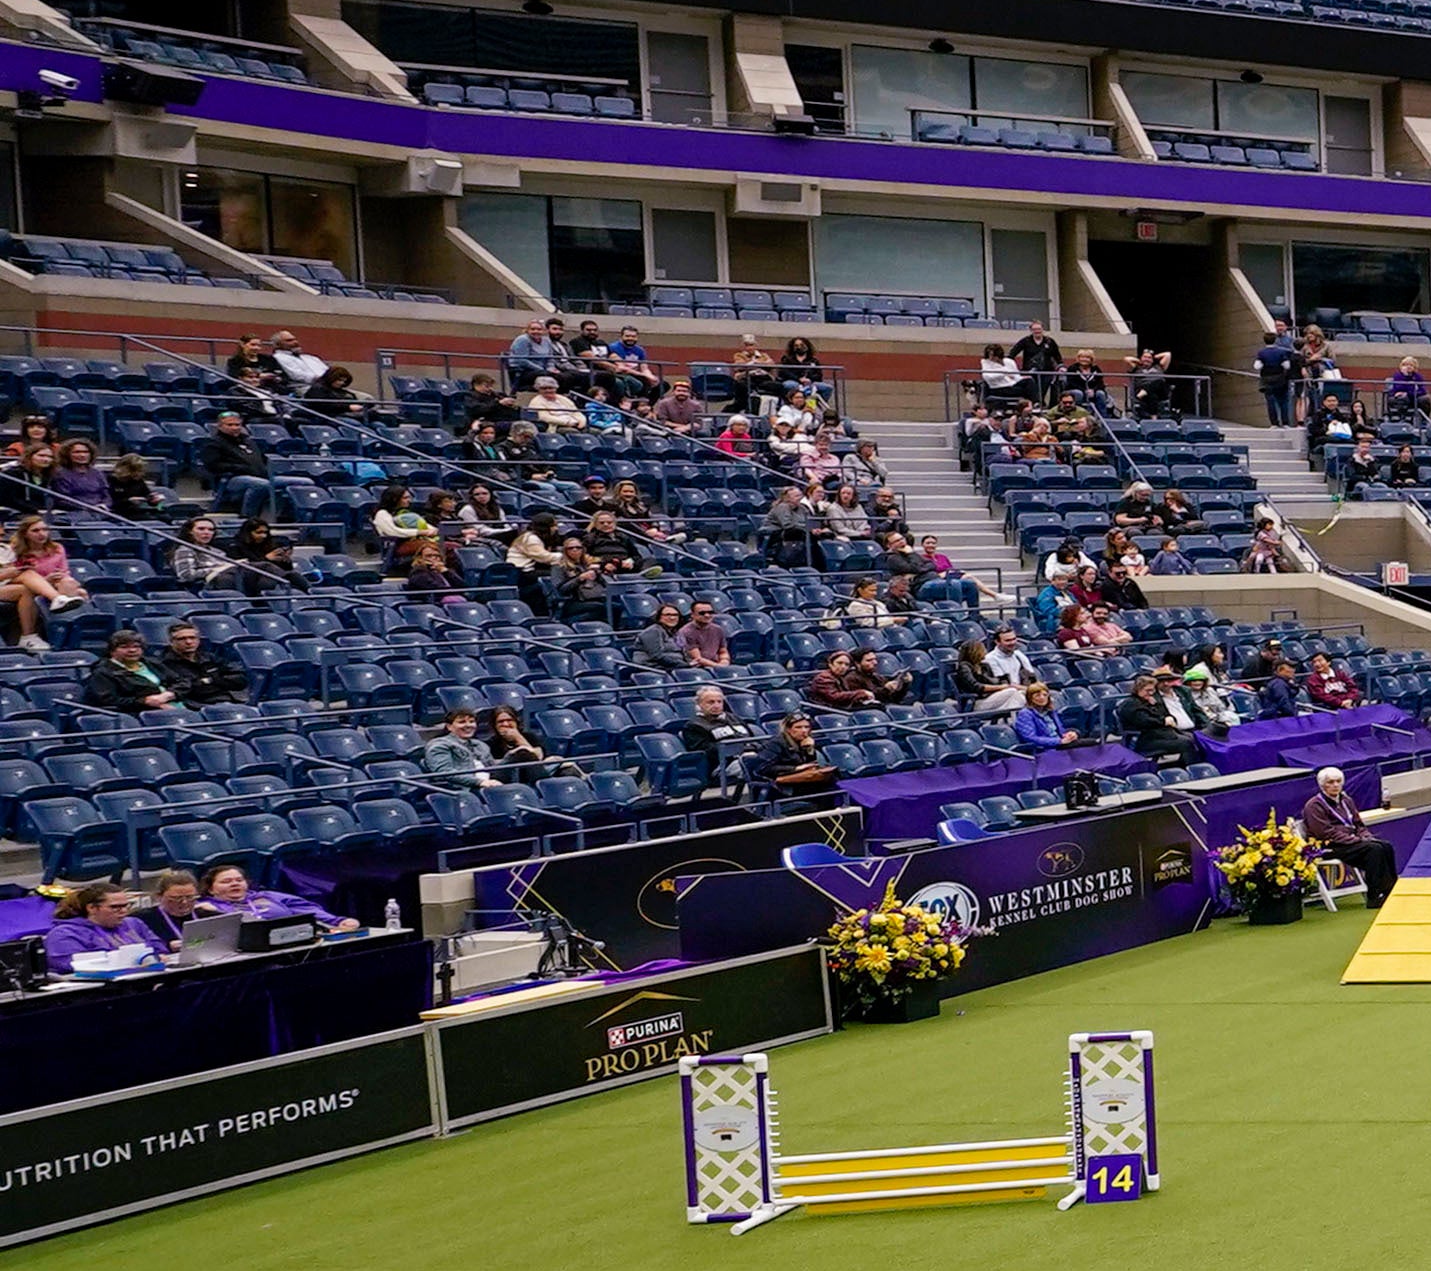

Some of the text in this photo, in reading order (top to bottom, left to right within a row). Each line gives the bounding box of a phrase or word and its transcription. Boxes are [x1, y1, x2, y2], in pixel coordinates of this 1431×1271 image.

[988, 867, 1133, 914] WESTMINSTER
[989, 885, 1133, 929] KENNEL CLUB DOG SHOW
[626, 1016, 680, 1040] PURINA
[585, 1030, 713, 1081] PRO PLAN
[0, 1142, 132, 1192] UTRITION
[140, 1124, 210, 1156] THAT
[1092, 1165, 1134, 1195] 14
